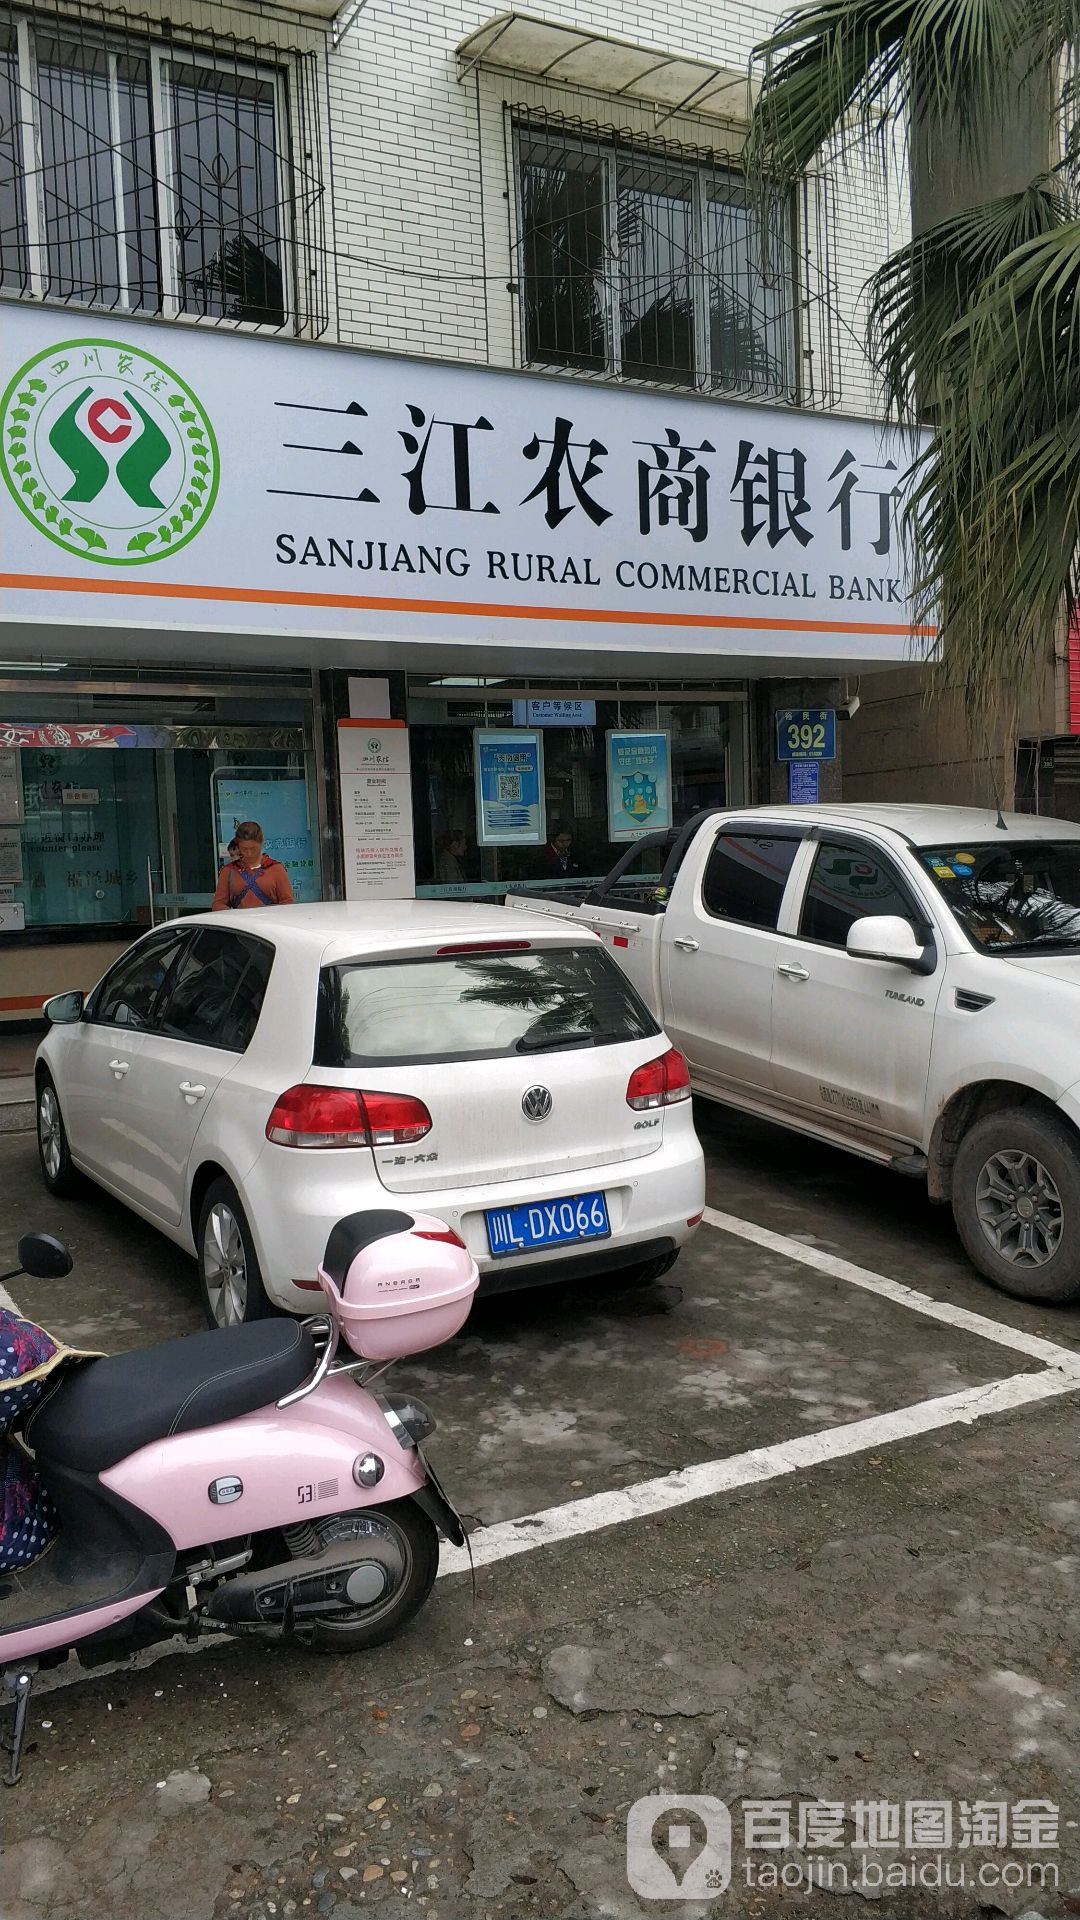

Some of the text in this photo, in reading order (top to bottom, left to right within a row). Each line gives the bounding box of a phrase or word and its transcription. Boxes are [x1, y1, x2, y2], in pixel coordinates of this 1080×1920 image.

[50, 347, 169, 393] 四川农信
[266, 400, 906, 556] 三江农商银行
[276, 534, 903, 603] SANJIANG RURAL COMMERCIAL BANK
[531, 700, 583, 711] 客户等候区
[787, 723, 826, 749] 392
[884, 989, 926, 1007] TUNLAND
[633, 1118, 661, 1130] GOLF
